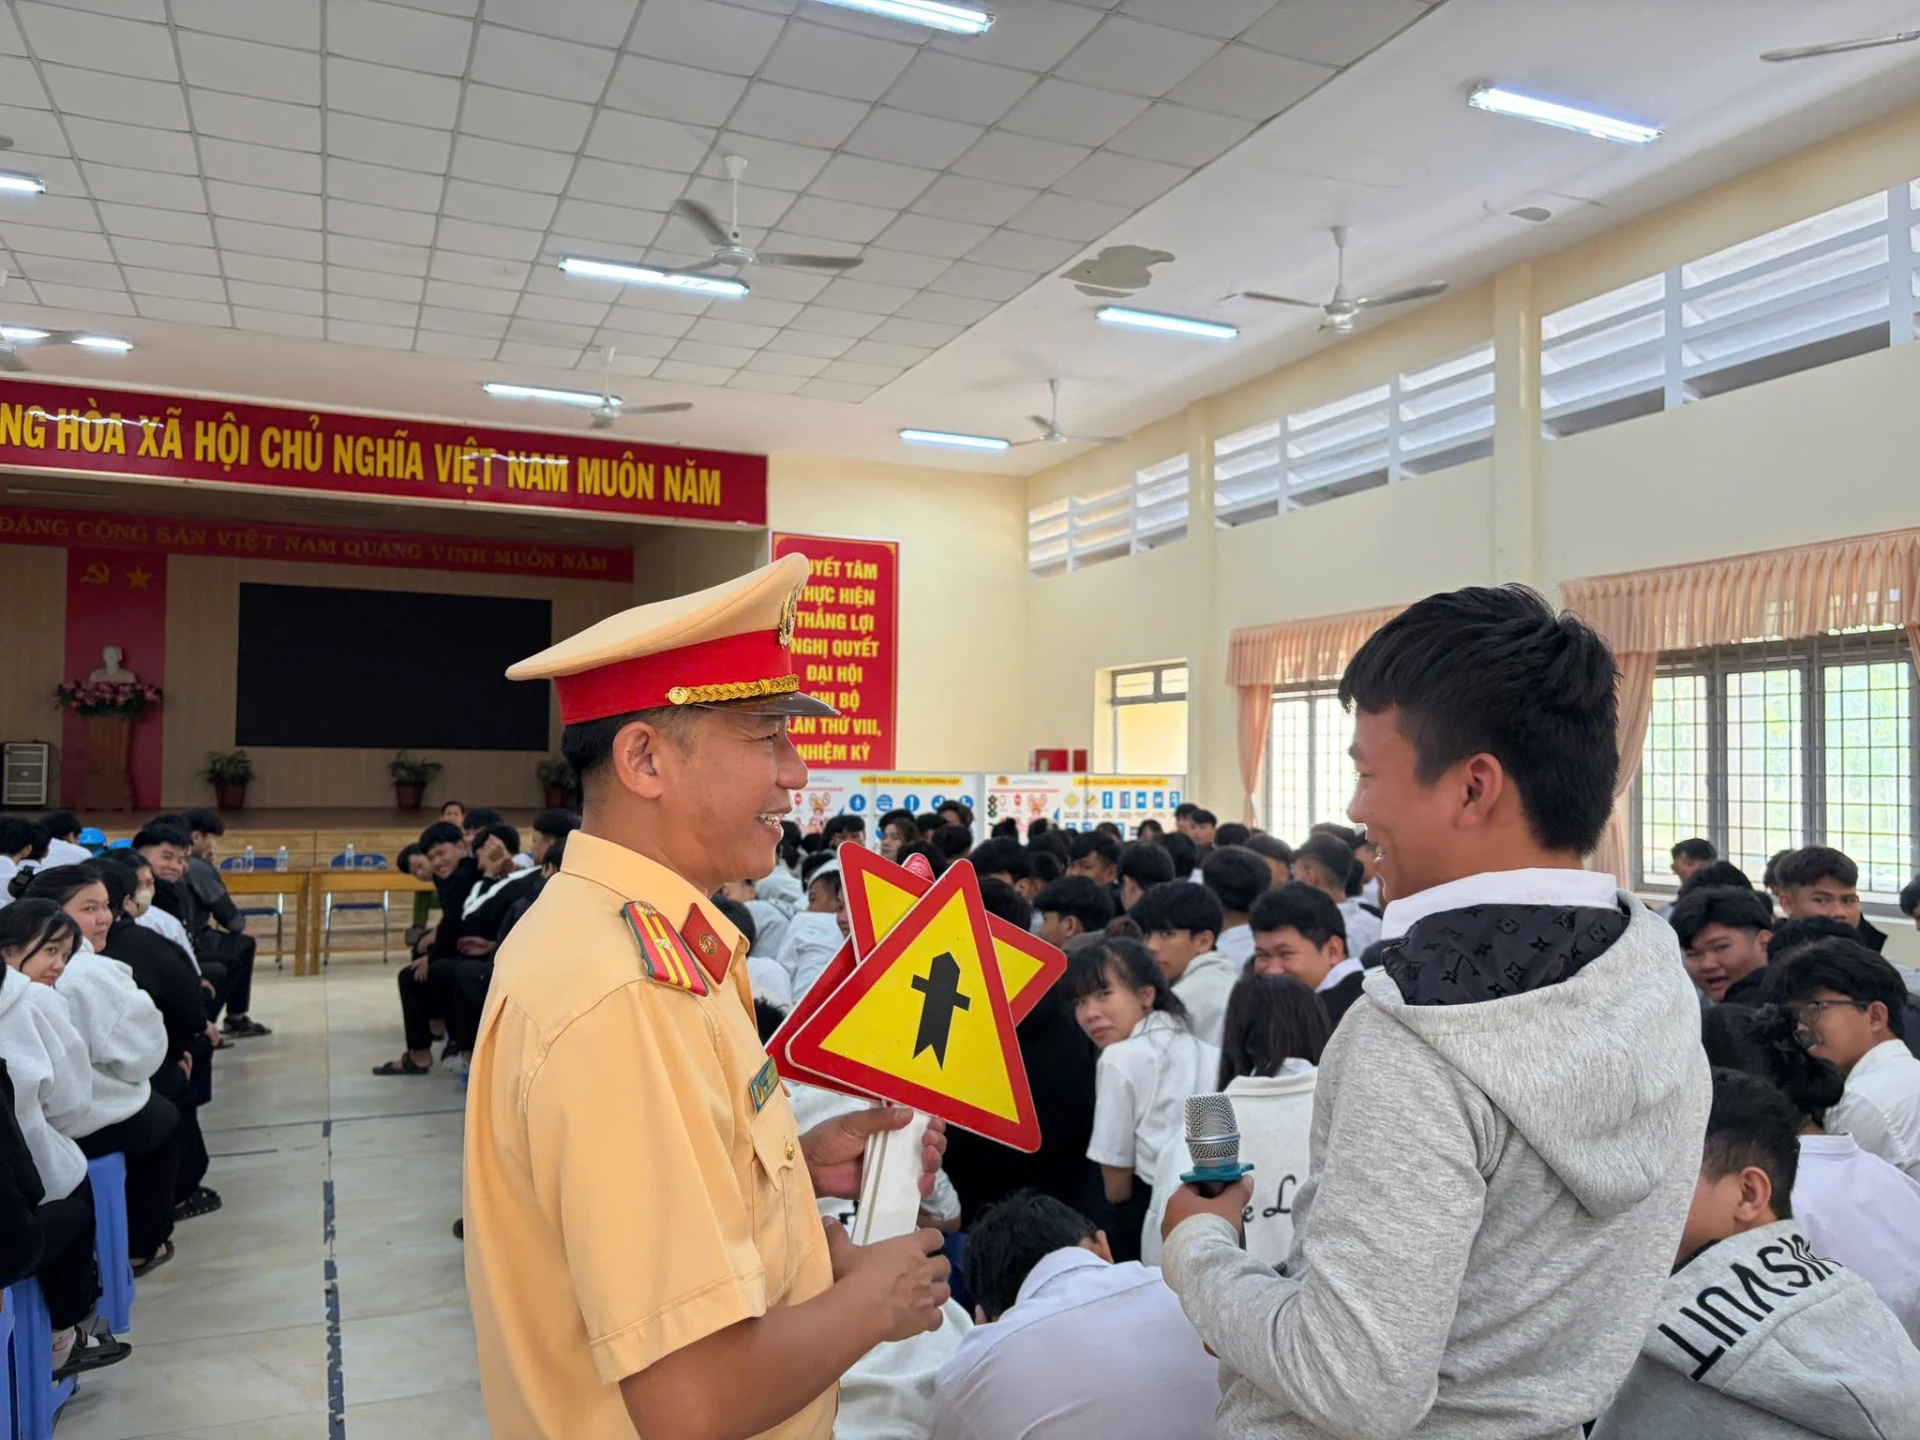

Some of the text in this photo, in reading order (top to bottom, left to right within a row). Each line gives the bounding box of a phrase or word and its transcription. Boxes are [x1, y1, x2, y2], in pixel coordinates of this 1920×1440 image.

[57, 397, 126, 455] HÒA
[137, 406, 184, 460] XÃ
[194, 411, 250, 472] HỘI
[260, 414, 324, 472] CHỦ
[333, 429, 424, 482] NGHĨA
[434, 436, 493, 494] VIỆT
[508, 450, 569, 493] NAM
[577, 450, 655, 500] MUÔN
[663, 458, 721, 507] NĂM
[0, 514, 70, 537] ĐẢNG
[76, 516, 148, 541] CỘNG
[156, 524, 206, 545] SẢN
[217, 529, 277, 551] VIỆT
[285, 536, 337, 554] NAM
[343, 540, 422, 560] QUANG
[431, 545, 487, 563] VINH
[493, 548, 556, 569] MUÔN
[809, 555, 878, 580] UYẾT TÂM
[839, 585, 876, 609] HIỆN
[850, 613, 874, 634] LỢI
[791, 635, 880, 659] NGHỊ QUYẾT
[806, 662, 863, 686] ĐẠI HỘI
[839, 688, 860, 712] BỘ
[796, 741, 871, 765] NHIỆM KỲ
